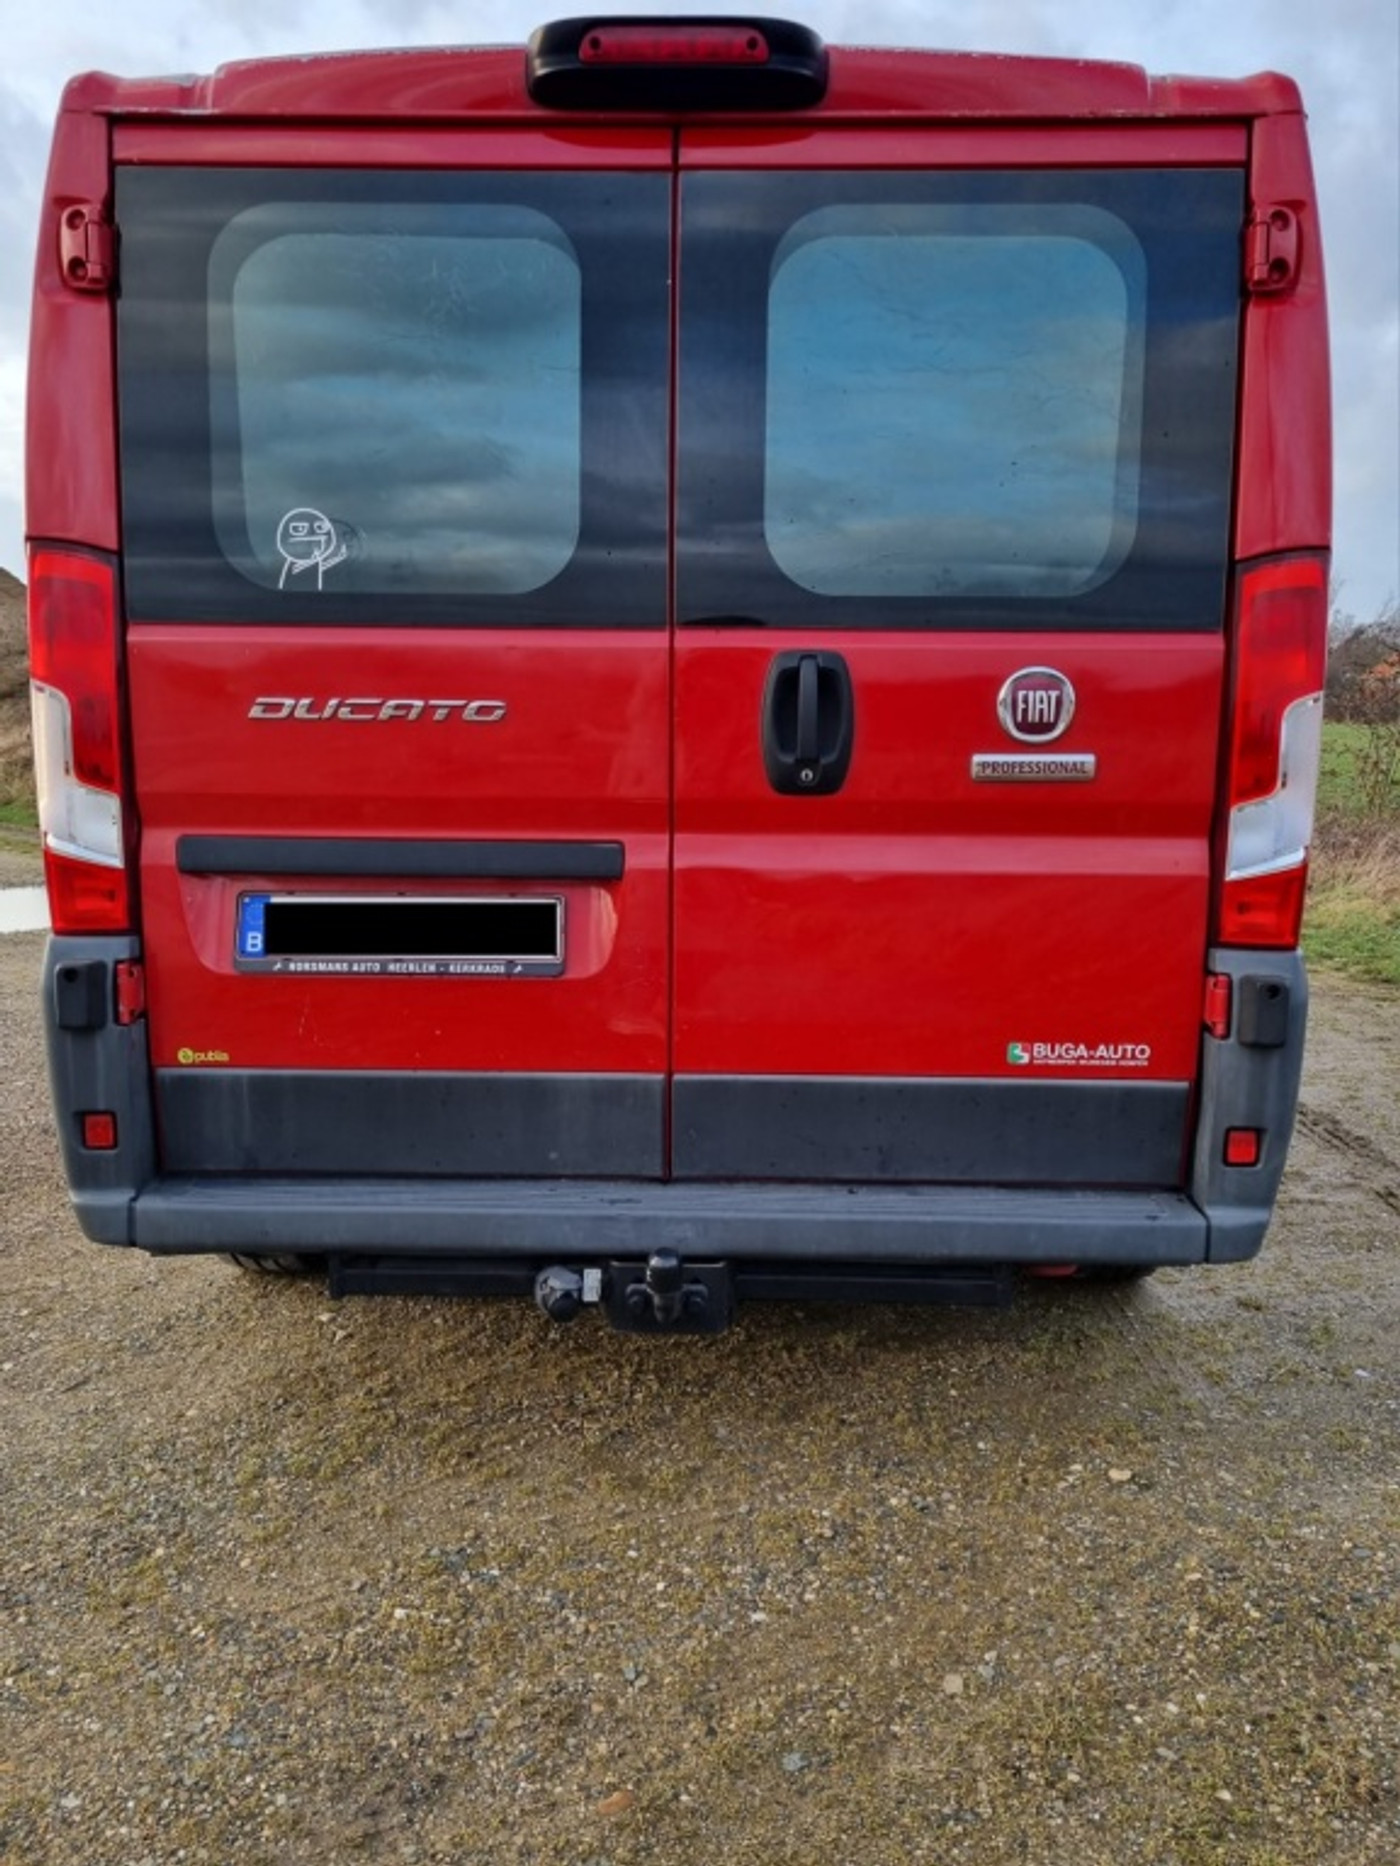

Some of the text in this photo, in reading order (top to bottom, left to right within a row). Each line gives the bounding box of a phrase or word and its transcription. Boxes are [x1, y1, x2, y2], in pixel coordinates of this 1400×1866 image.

[247, 697, 506, 721] DUCATO
[1016, 690, 1060, 723] FIAT
[981, 760, 1089, 775] PROFESSIONAL
[246, 931, 263, 952] B
[352, 961, 381, 973] AUTO
[1033, 1043, 1151, 1059] BUGA-AUTO
